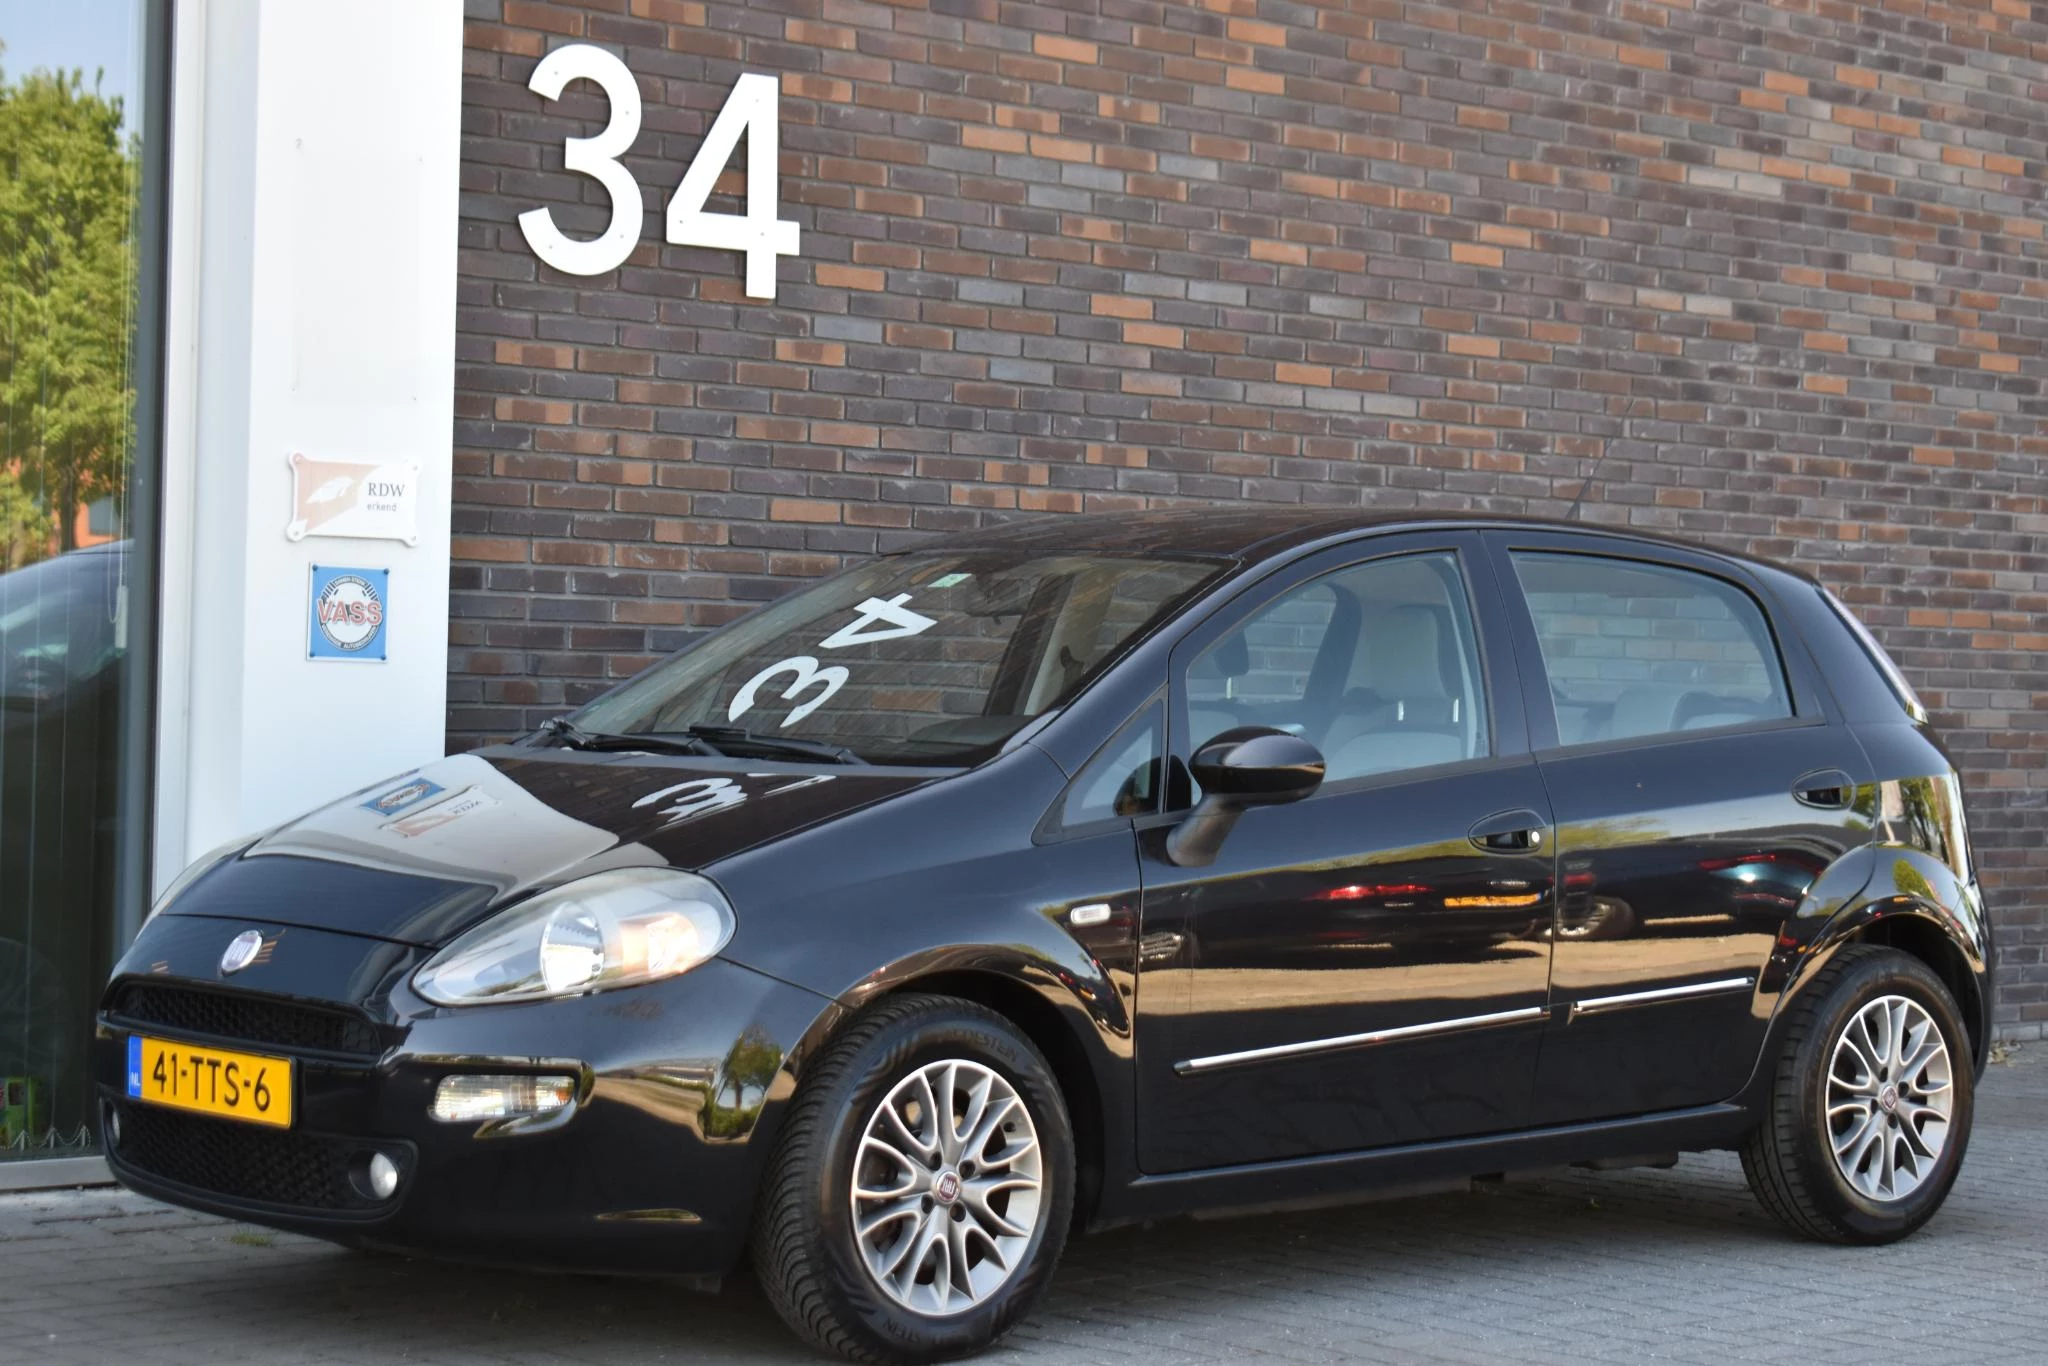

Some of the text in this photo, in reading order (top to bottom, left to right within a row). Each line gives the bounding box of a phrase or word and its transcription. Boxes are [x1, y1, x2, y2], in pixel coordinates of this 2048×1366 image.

[518, 44, 800, 299] 34
[368, 482, 406, 497] RDW
[366, 502, 397, 512] erkend
[316, 599, 382, 625] VASS
[130, 1071, 141, 1087] NL
[153, 1050, 271, 1112] 41-TTS-6
